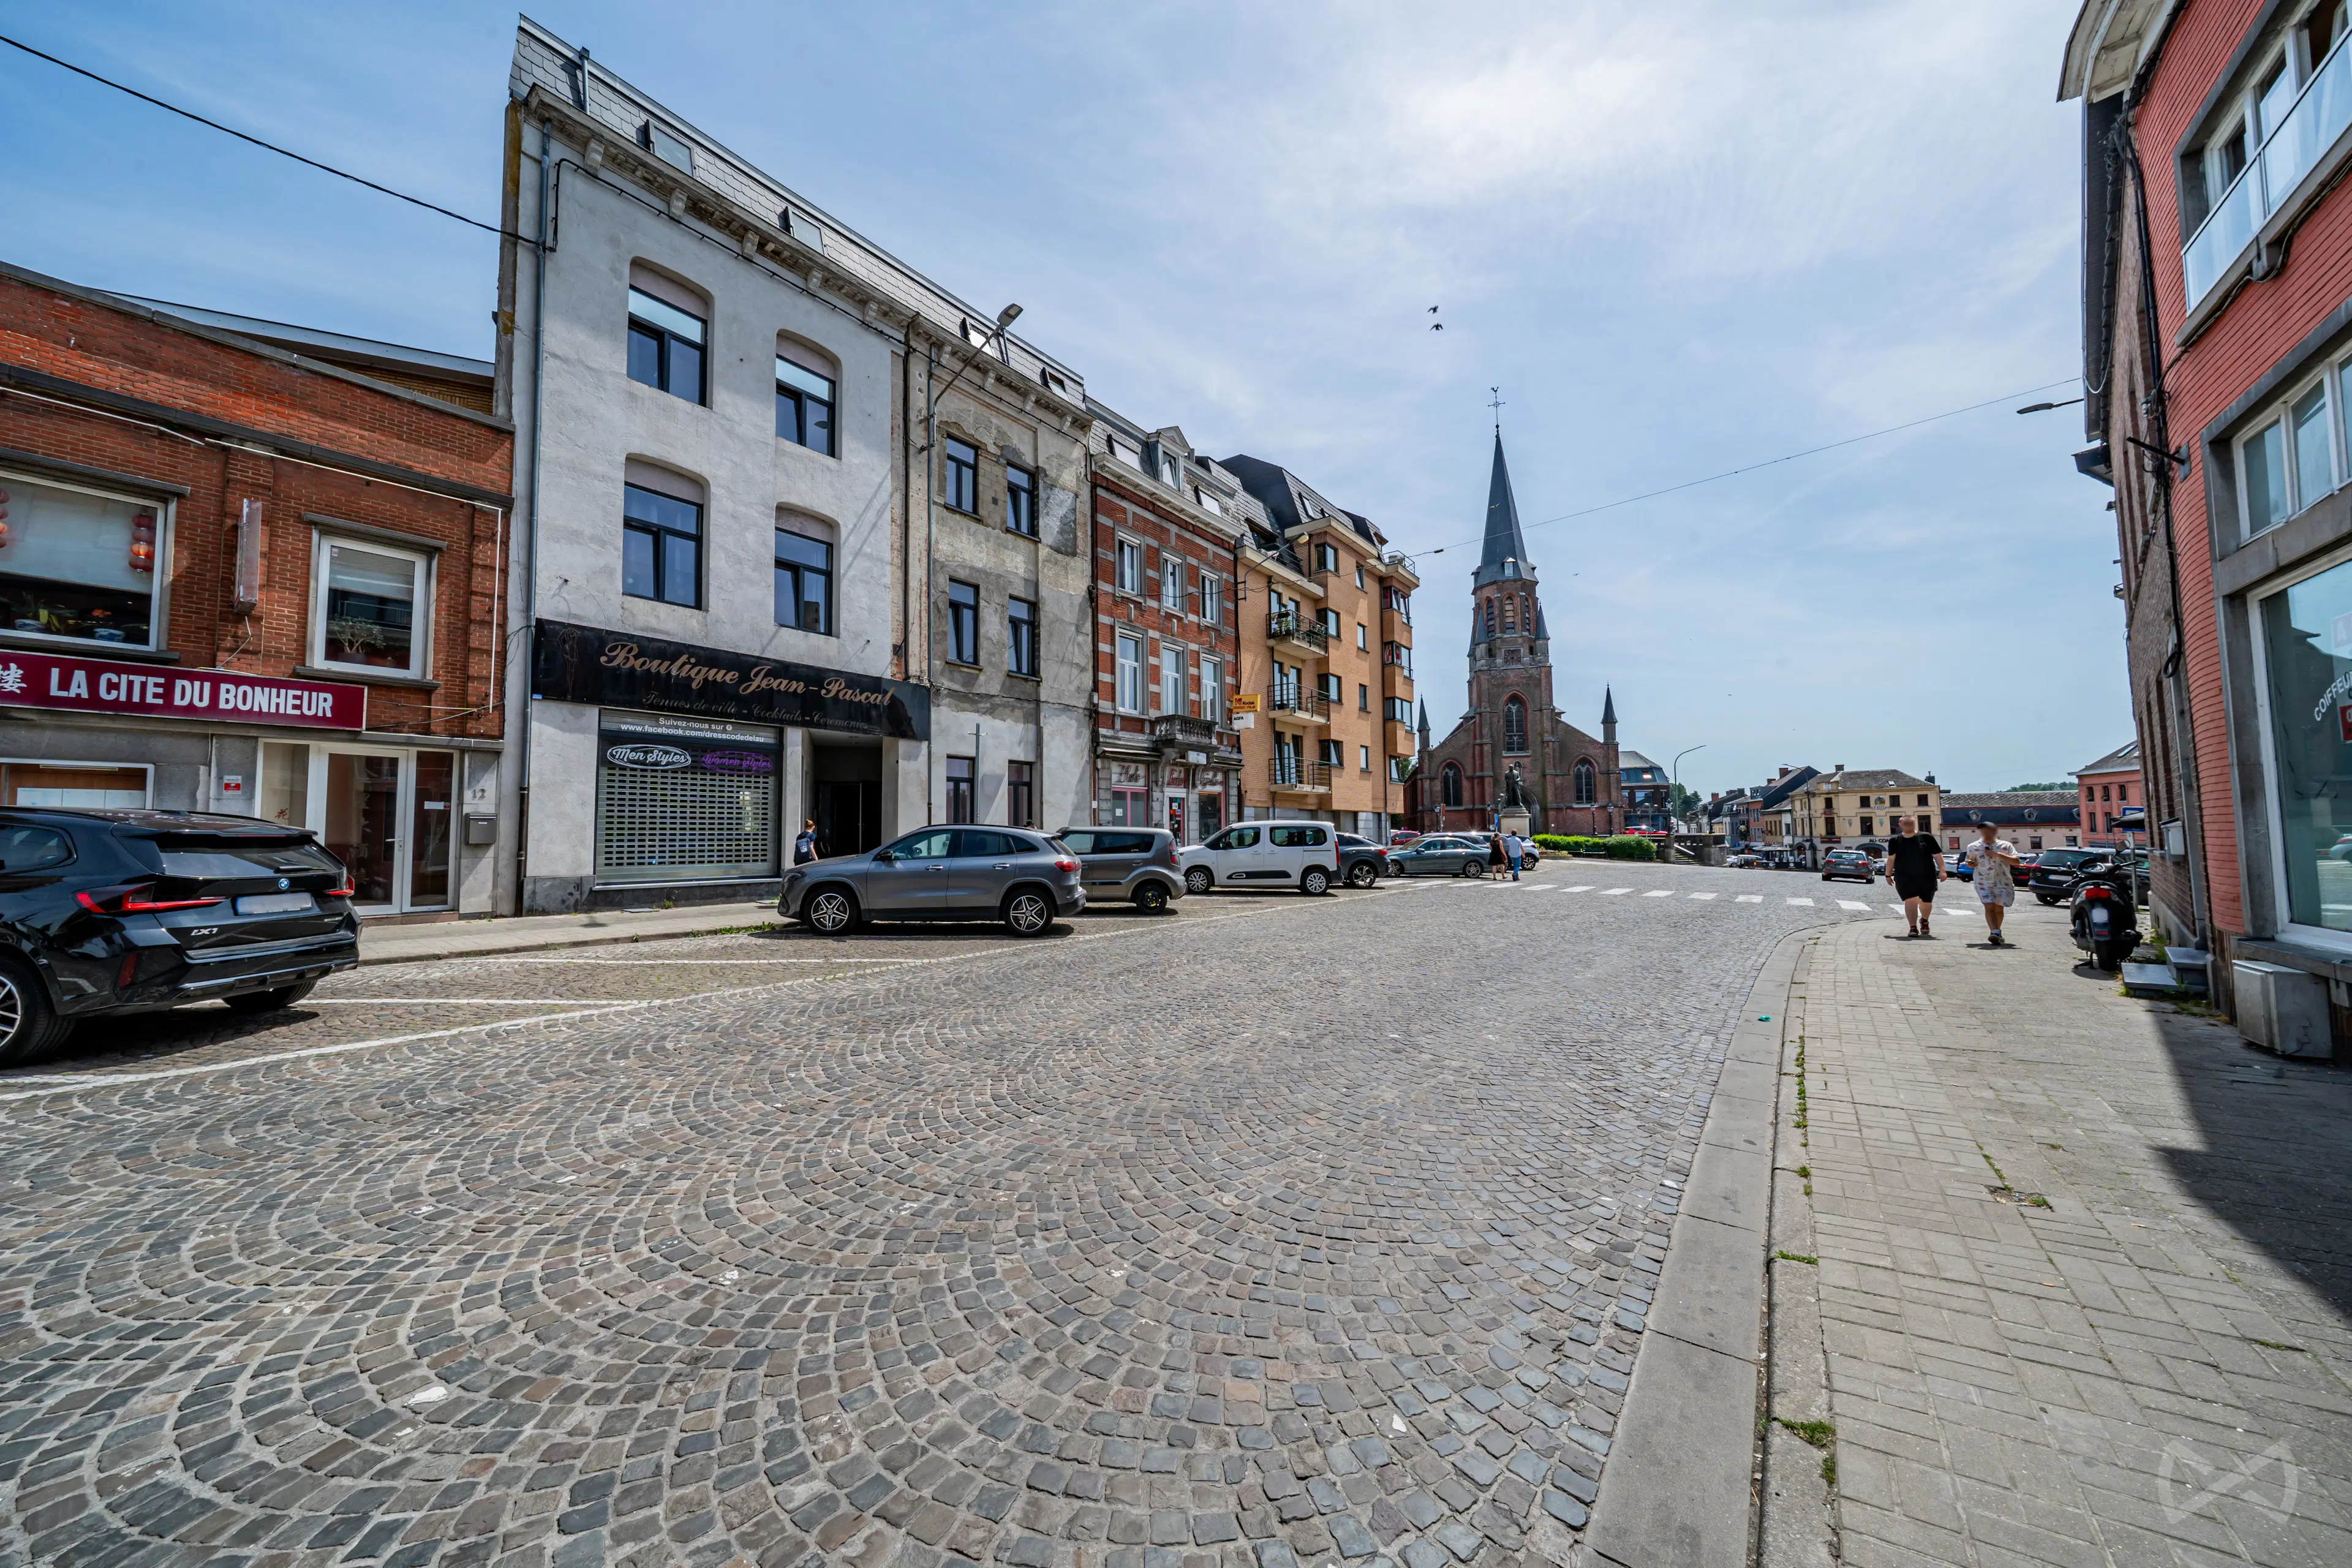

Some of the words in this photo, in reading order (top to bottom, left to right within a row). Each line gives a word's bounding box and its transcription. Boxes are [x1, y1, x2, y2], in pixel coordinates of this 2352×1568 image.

[600, 642, 739, 690] Boutique
[50, 668, 89, 698] LA
[99, 673, 165, 704] CITE
[174, 679, 211, 707] DU
[219, 683, 333, 717] BONHEUR
[2314, 671, 2352, 722] COIFFEU
[643, 690, 690, 709] Tenues
[693, 699, 708, 710] de
[712, 701, 738, 714] ville
[752, 704, 802, 722] Cocktails
[658, 717, 709, 729] Suivez-nous
[620, 724, 764, 742] www.facebook.com/dresscodedelau
[612, 747, 645, 761] Men
[646, 749, 687, 764] Styles
[703, 754, 741, 766] Women
[742, 756, 772, 771] Styles
[471, 788, 486, 799] 12
